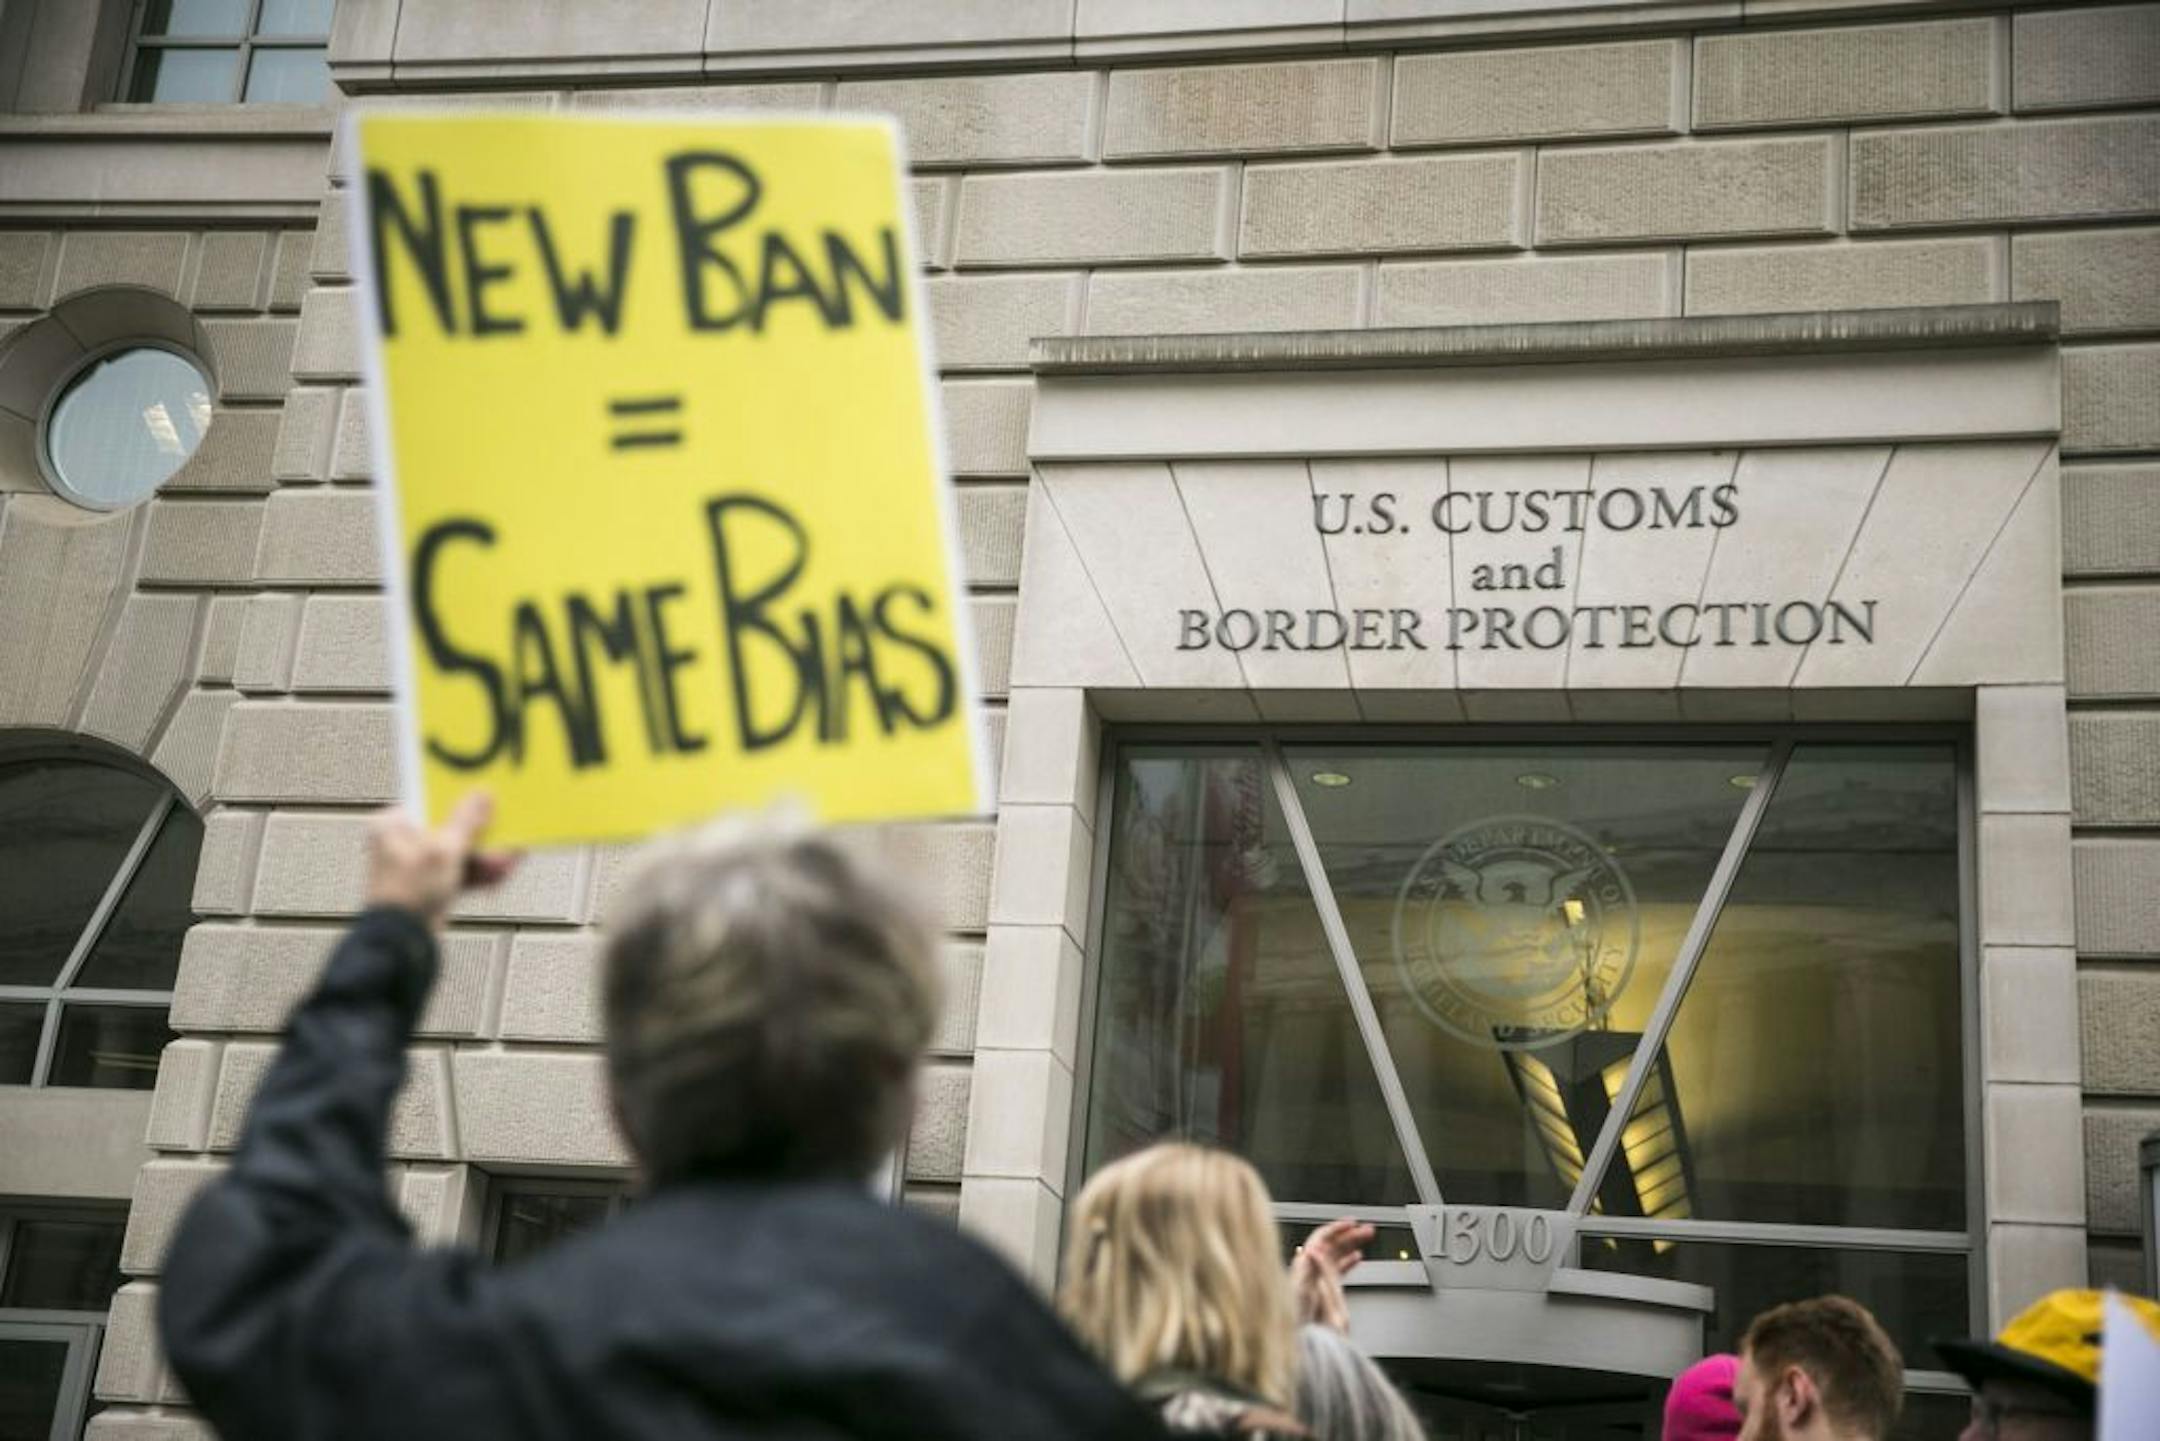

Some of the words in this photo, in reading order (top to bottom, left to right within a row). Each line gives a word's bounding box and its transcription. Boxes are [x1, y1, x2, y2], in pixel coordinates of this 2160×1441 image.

[367, 166, 636, 338] NEW
[663, 150, 907, 335] BAN
[608, 395, 683, 450] =
[1310, 493, 1410, 534] U.S.
[1431, 485, 1740, 533] CUSTOMS
[1471, 546, 1566, 591] and
[411, 518, 710, 771] SAME
[703, 492, 959, 754] BIAS
[1176, 609, 1427, 651] BORDER
[1445, 600, 1877, 650] PROTECTION
[1428, 1209, 1551, 1265] 1300
